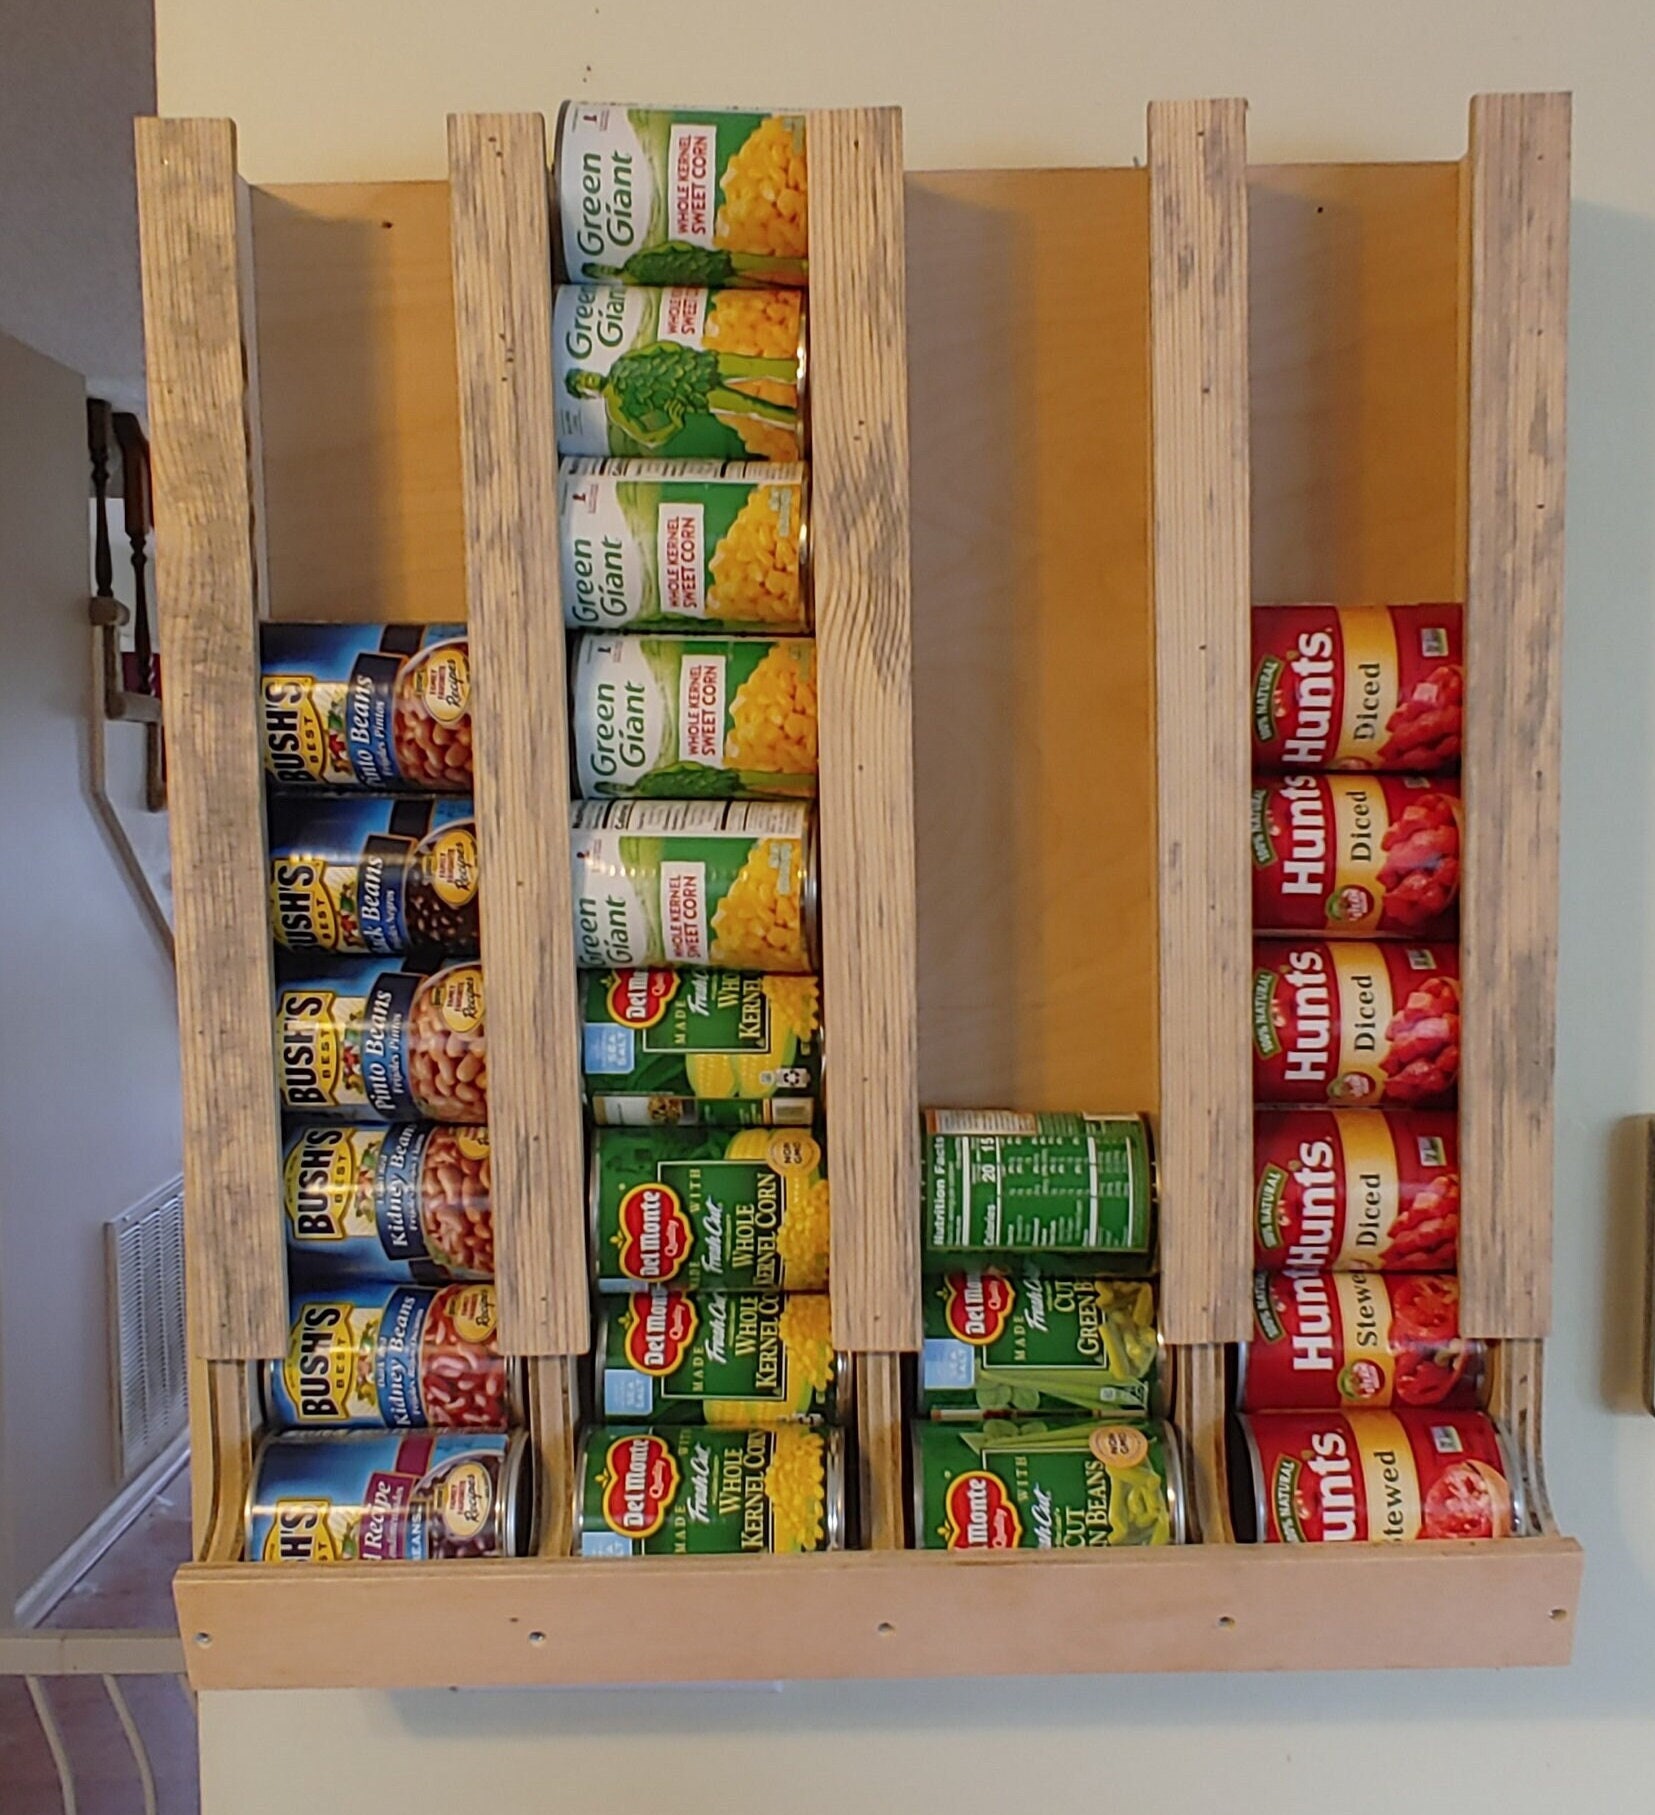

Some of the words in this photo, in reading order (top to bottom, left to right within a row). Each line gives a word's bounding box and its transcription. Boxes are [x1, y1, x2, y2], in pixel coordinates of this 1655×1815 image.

[678, 135, 691, 180] KERNEL
[693, 136, 707, 179] CORN
[577, 153, 604, 256] Green
[606, 150, 634, 246] Giant
[677, 185, 689, 234] WHOLE
[692, 183, 706, 234] SWEET
[597, 288, 625, 347] Gian
[667, 516, 679, 566] KERNEL
[681, 517, 695, 563] CORN
[572, 539, 599, 622] Green
[599, 536, 627, 617] Giant
[667, 569, 680, 608] WHOLE
[681, 566, 697, 608] SWEET
[446, 659, 464, 708] Recipes
[689, 665, 701, 708] KERNEL
[702, 665, 716, 705] CORN
[1256, 661, 1278, 714] NATURAL
[1353, 663, 1380, 740] Diced
[264, 682, 310, 780] BUSH'S
[349, 675, 373, 744] Beans
[374, 701, 386, 738] Pintos
[591, 684, 617, 776] Green
[619, 681, 645, 768] Giant
[688, 711, 699, 756] WHOLE
[702, 709, 715, 756] SWEET
[304, 716, 319, 763] BEST
[1346, 791, 1373, 862] Diced
[361, 857, 383, 920] Beans
[454, 842, 471, 890] Recipes
[277, 865, 318, 944] USH'S
[317, 899, 331, 940] BEST
[669, 875, 681, 922] KERNEL
[683, 875, 698, 919] CORN
[578, 898, 606, 966] Green
[604, 895, 633, 964] Giant
[670, 925, 683, 957] WHOLE
[684, 923, 699, 958] SWEET
[718, 975, 740, 1008] WHO
[740, 977, 761, 1038] KERNEL
[1254, 974, 1273, 1022] NATURAL
[1351, 975, 1376, 1051] Diced
[364, 990, 392, 1057] Beans
[389, 1013, 401, 1050] Pintos
[675, 1000, 686, 1044] MADE
[283, 996, 327, 1103] BUSH'S
[321, 1028, 331, 1079] BEST
[368, 1063, 396, 1110] Pinto
[980, 1137, 995, 1151] 15
[297, 1130, 343, 1234] BUSH'S
[690, 1168, 700, 1213] WITH
[981, 1164, 996, 1182] 20
[1260, 1172, 1280, 1223] NATURAL
[386, 1175, 409, 1247] Kidney
[640, 1191, 660, 1251] Monte
[755, 1173, 777, 1228] CORN
[934, 1180, 946, 1245] Nutrition
[1356, 1173, 1380, 1246] Diced
[732, 1204, 754, 1268] WHOLE
[754, 1232, 776, 1285] KERNEL
[640, 1253, 659, 1276] Del
[759, 1295, 779, 1314] CO
[1054, 1281, 1076, 1312] CUT
[1351, 1273, 1378, 1347] Stewe
[387, 1295, 416, 1352] Beans
[735, 1296, 758, 1356] WHOLE
[1013, 1315, 1026, 1360] MADE
[1076, 1295, 1100, 1355] GREEN
[300, 1307, 340, 1416] BUSH'S
[336, 1337, 345, 1389] BEST
[644, 1336, 665, 1365] Del
[693, 1346, 704, 1391] MADE
[756, 1317, 778, 1388] KERNEL
[388, 1359, 412, 1425] Kidney
[625, 1440, 649, 1491] Monte
[719, 1448, 742, 1514] WHOLE
[1015, 1456, 1028, 1501] WITH
[1277, 1461, 1295, 1517] NATURAL
[362, 1480, 392, 1549] Recipe
[464, 1474, 481, 1523] Recipes
[623, 1494, 644, 1527] Del
[741, 1472, 764, 1548] KERNEL
[968, 1479, 988, 1543] Monte
[1084, 1460, 1107, 1525] BEANS
[1373, 1451, 1404, 1541] tewed
[675, 1505, 686, 1552] MADE
[1063, 1506, 1085, 1549] CUT
